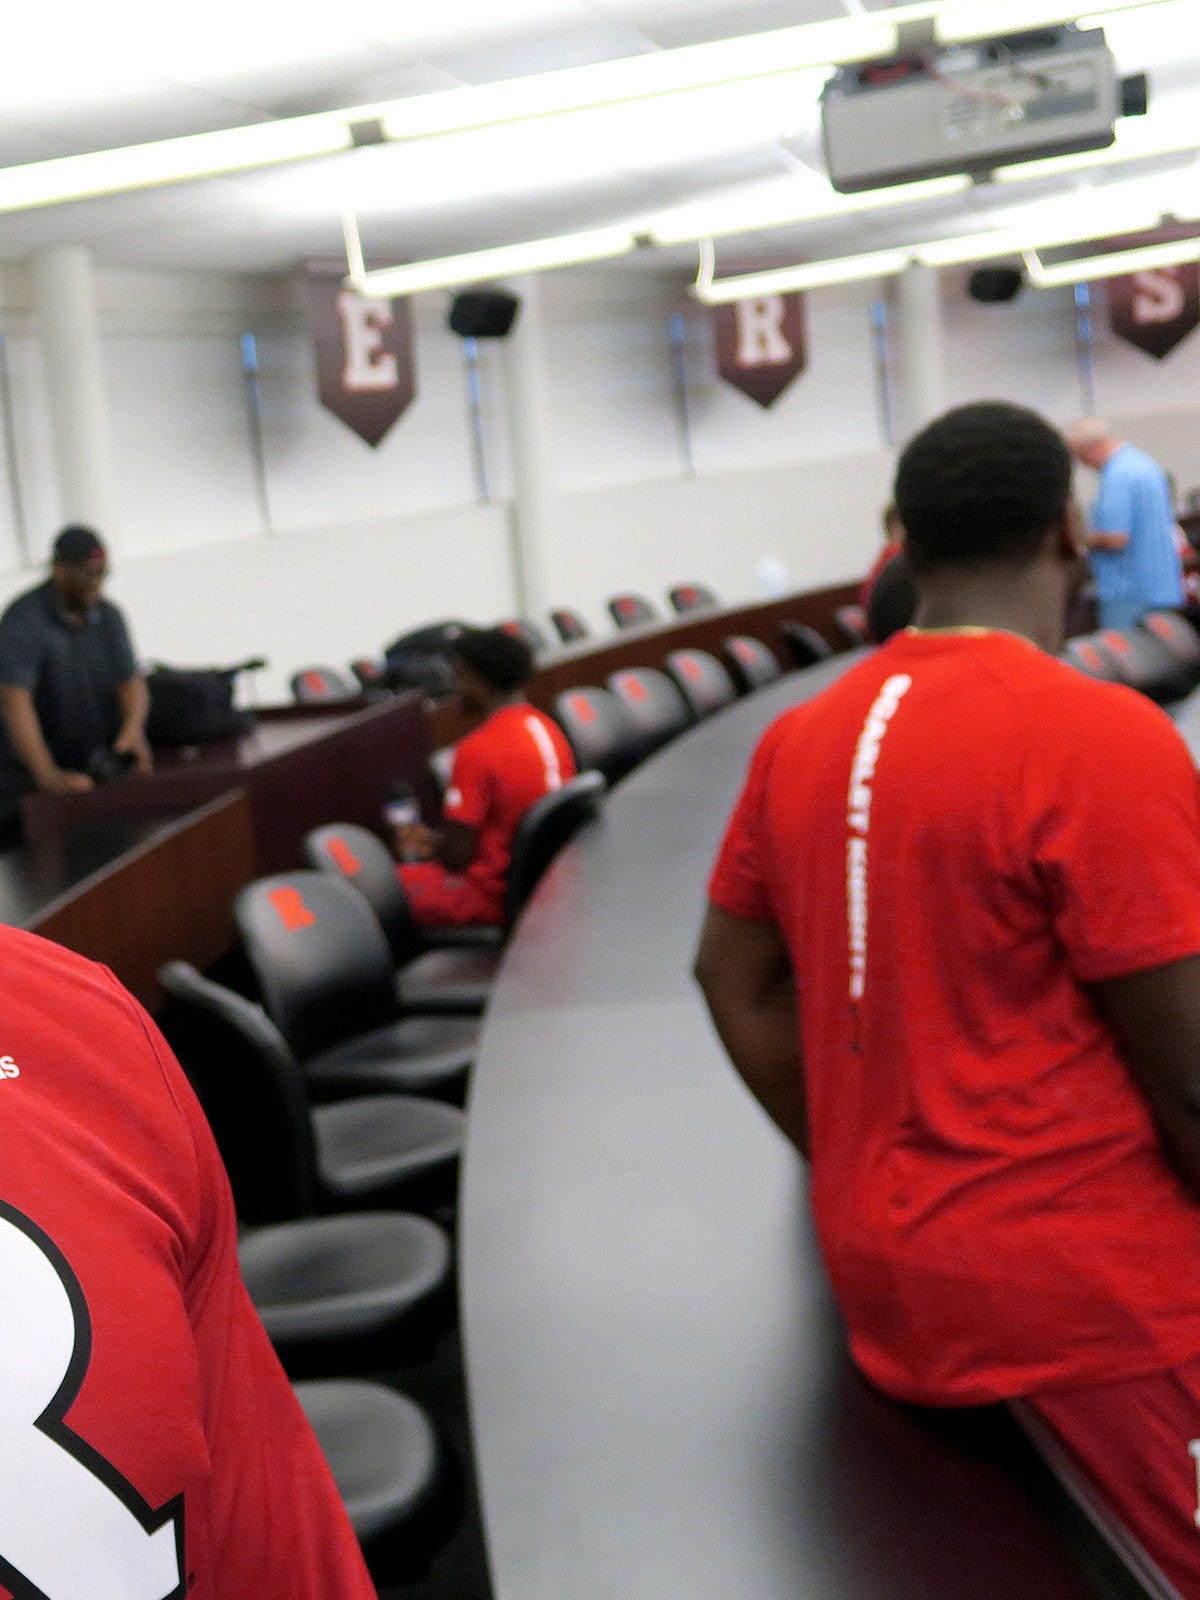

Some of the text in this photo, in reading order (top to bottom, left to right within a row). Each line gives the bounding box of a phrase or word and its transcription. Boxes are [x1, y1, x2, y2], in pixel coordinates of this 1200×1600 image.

[736, 292, 793, 368] R
[1132, 266, 1184, 324] S
[337, 290, 399, 390] E
